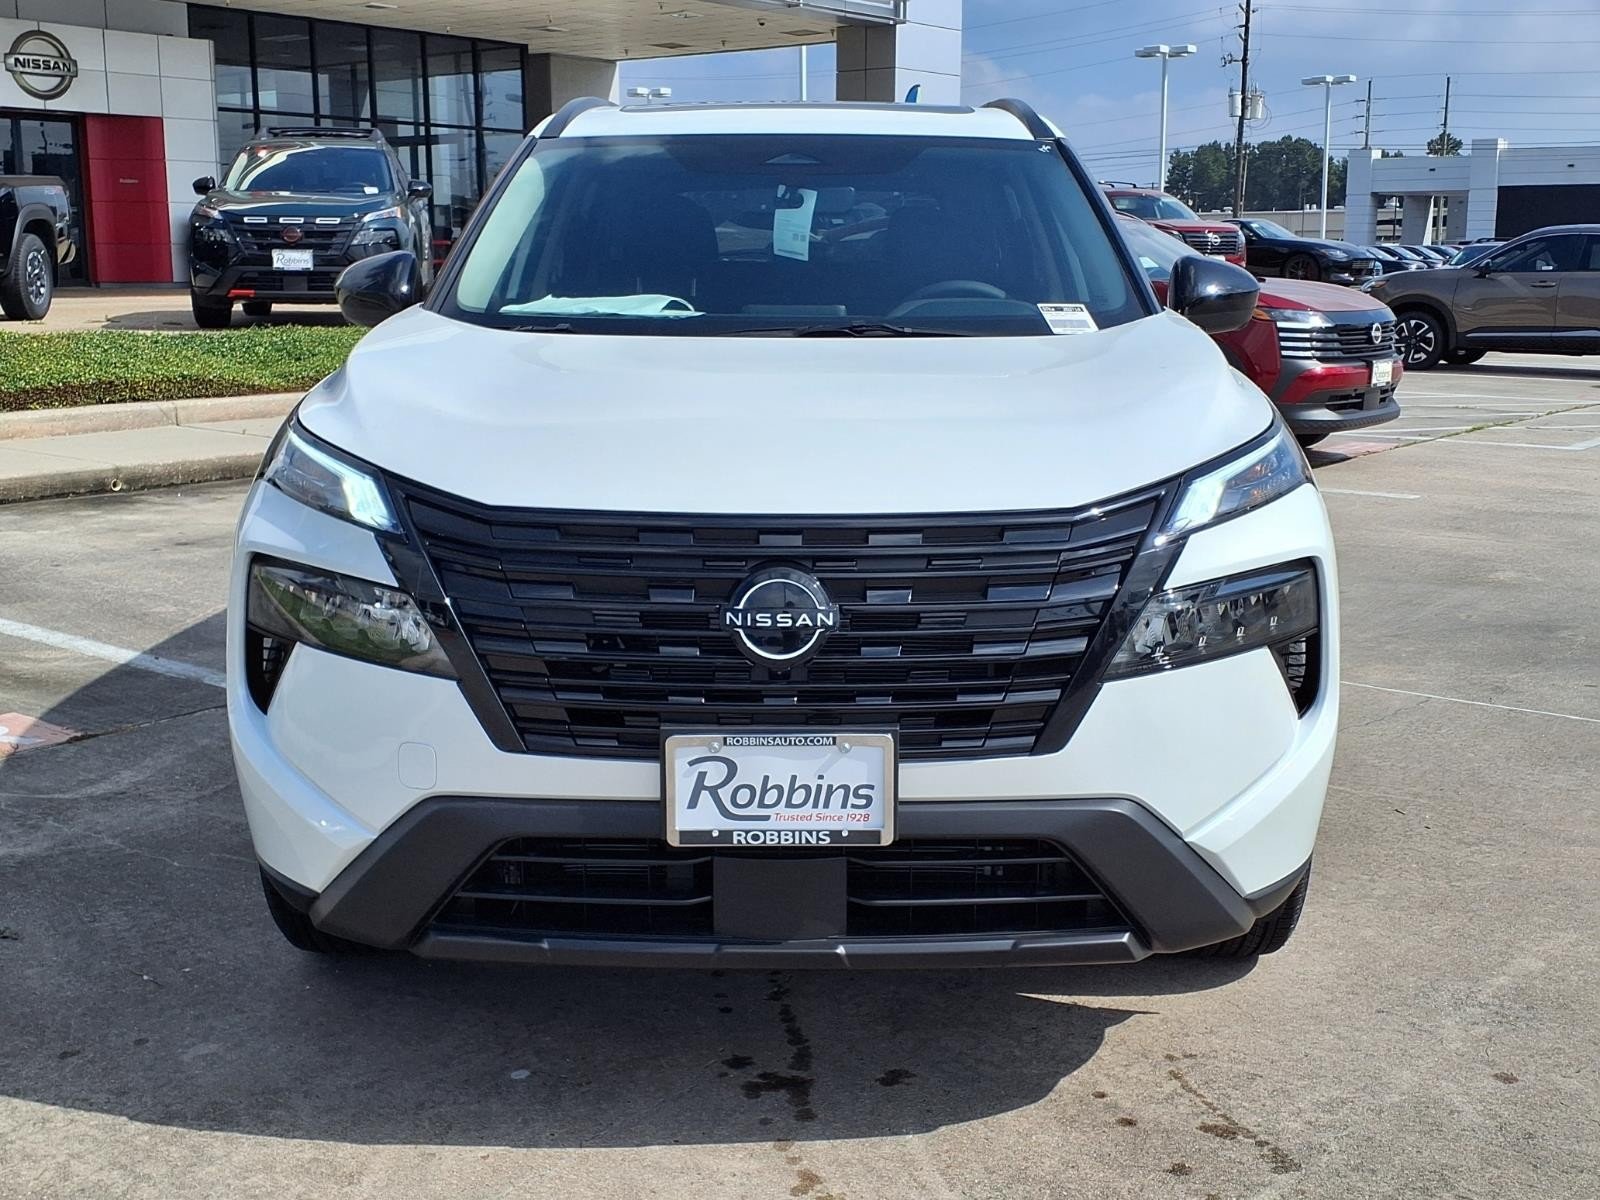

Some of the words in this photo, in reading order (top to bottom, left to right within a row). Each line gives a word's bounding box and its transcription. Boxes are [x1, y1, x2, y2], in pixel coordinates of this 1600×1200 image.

[14, 57, 72, 73] NISSAN
[726, 611, 834, 627] NISSAN
[726, 736, 833, 747] ROBBINSAUTO.COM
[686, 755, 876, 822] Robbins
[774, 812, 812, 822] Trusted
[815, 812, 843, 822] Since
[846, 813, 870, 823] 1928
[732, 830, 831, 845] ROBBINS
